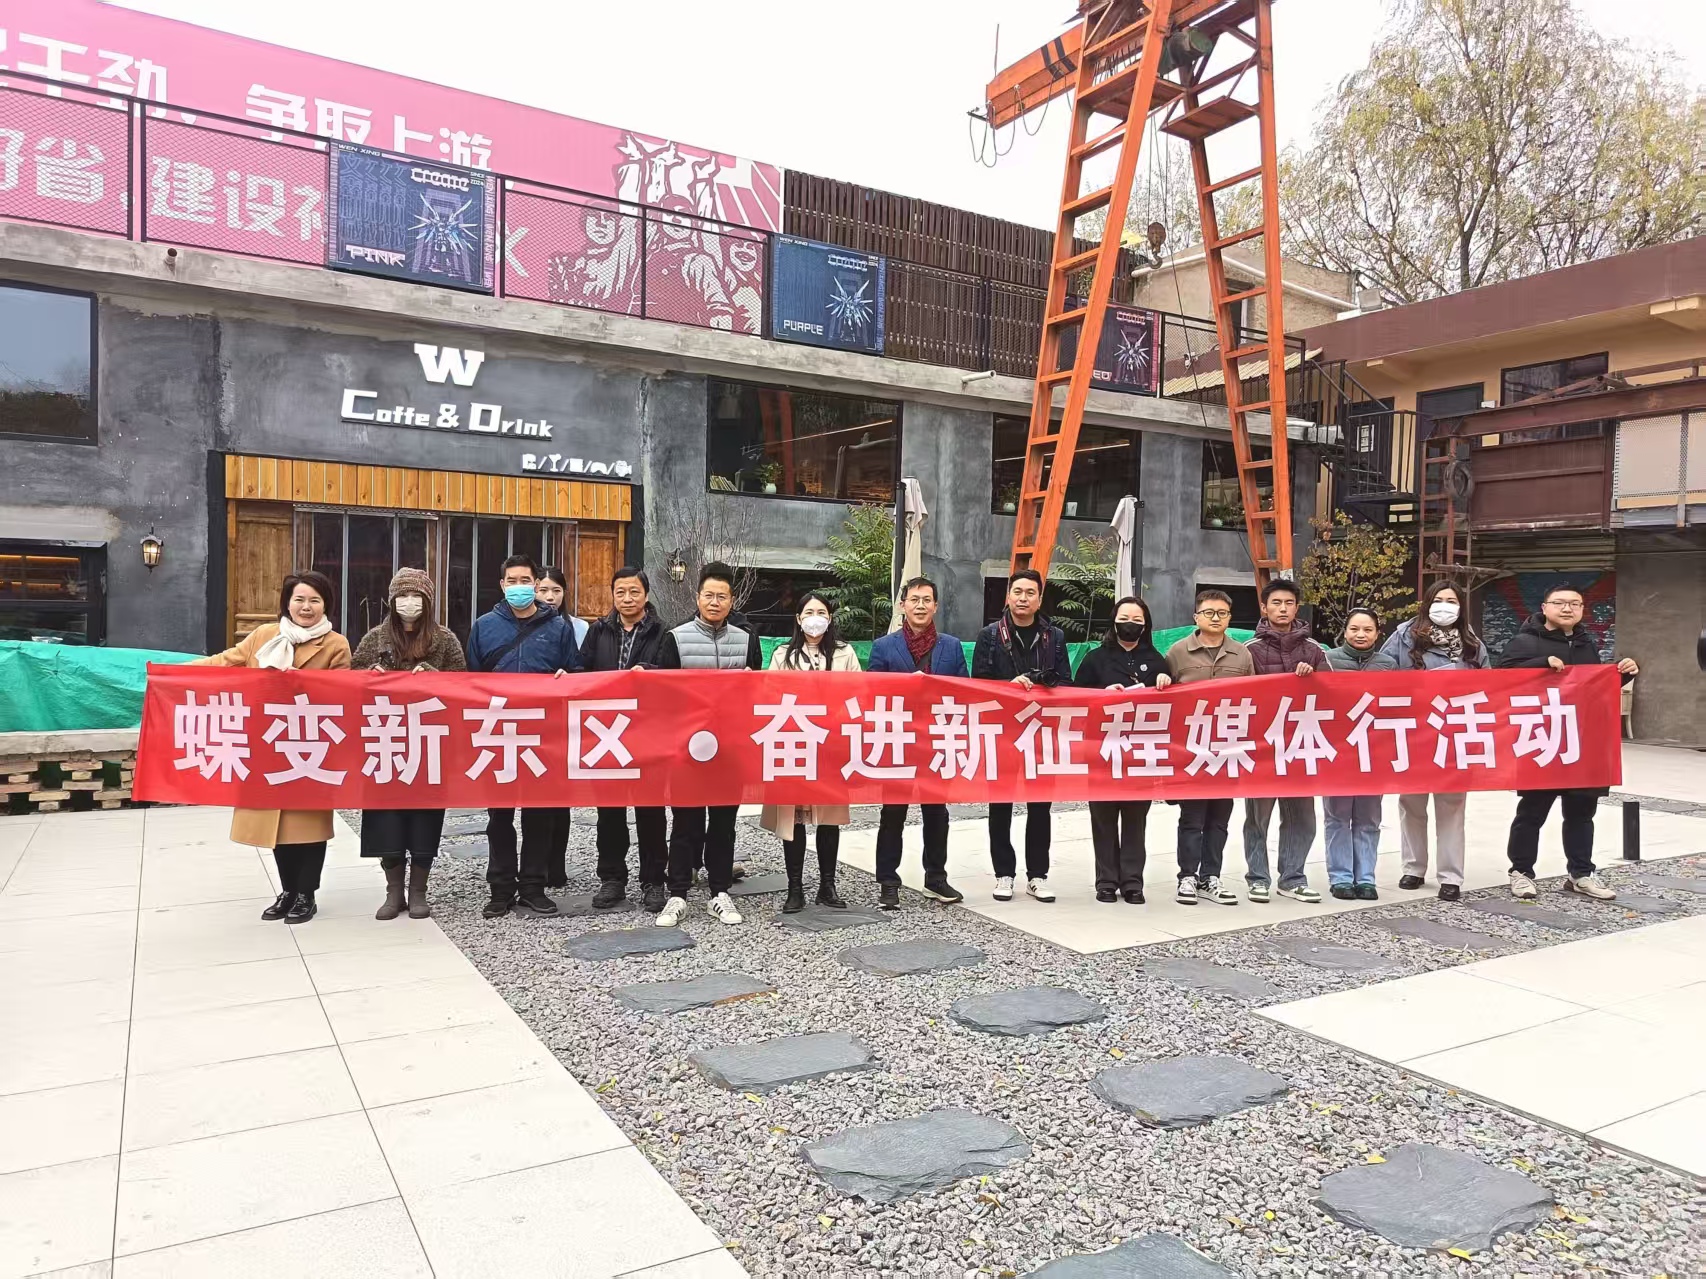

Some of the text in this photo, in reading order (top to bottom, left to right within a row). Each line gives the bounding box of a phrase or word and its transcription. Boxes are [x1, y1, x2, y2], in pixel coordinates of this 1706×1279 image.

[345, 244, 406, 268] PINK
[783, 319, 824, 336] PURPLE
[413, 342, 486, 388] W
[1090, 368, 1112, 381] ED
[341, 387, 431, 428] Coffe
[436, 402, 460, 429] &
